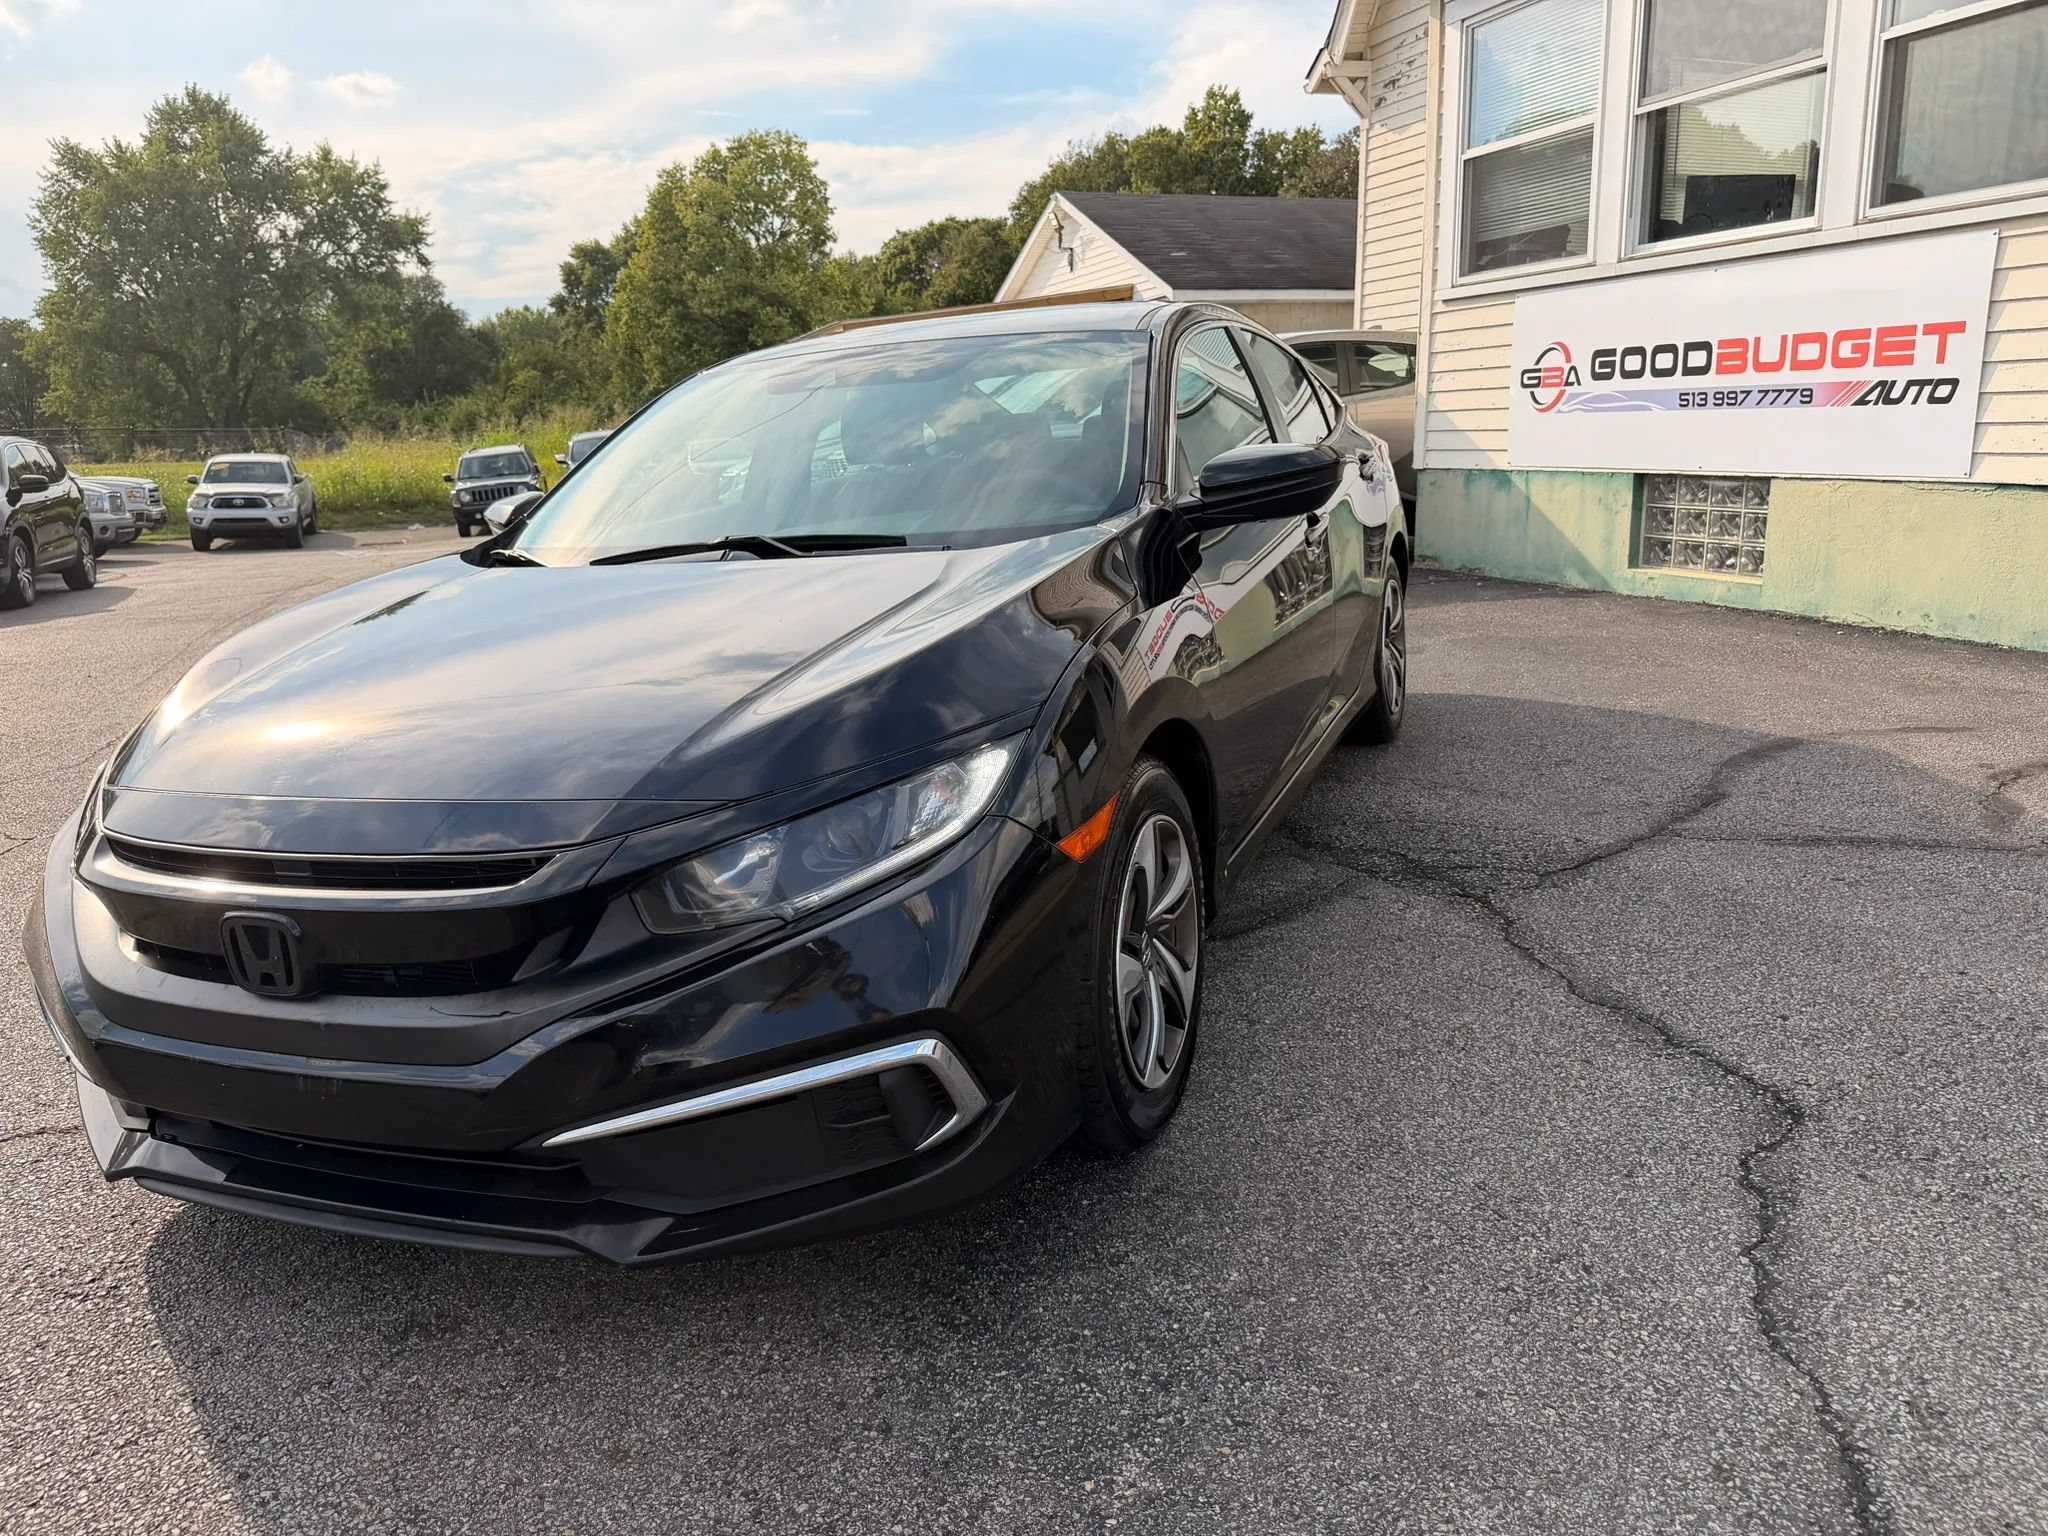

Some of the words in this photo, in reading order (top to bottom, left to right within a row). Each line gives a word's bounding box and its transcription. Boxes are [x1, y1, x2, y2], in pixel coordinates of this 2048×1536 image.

[1520, 365, 1582, 389] GBA
[1678, 391, 1708, 408] 513
[1712, 389, 1753, 407] 997
[1755, 387, 1813, 406] 7779
[1850, 377, 1960, 407] AUTO
